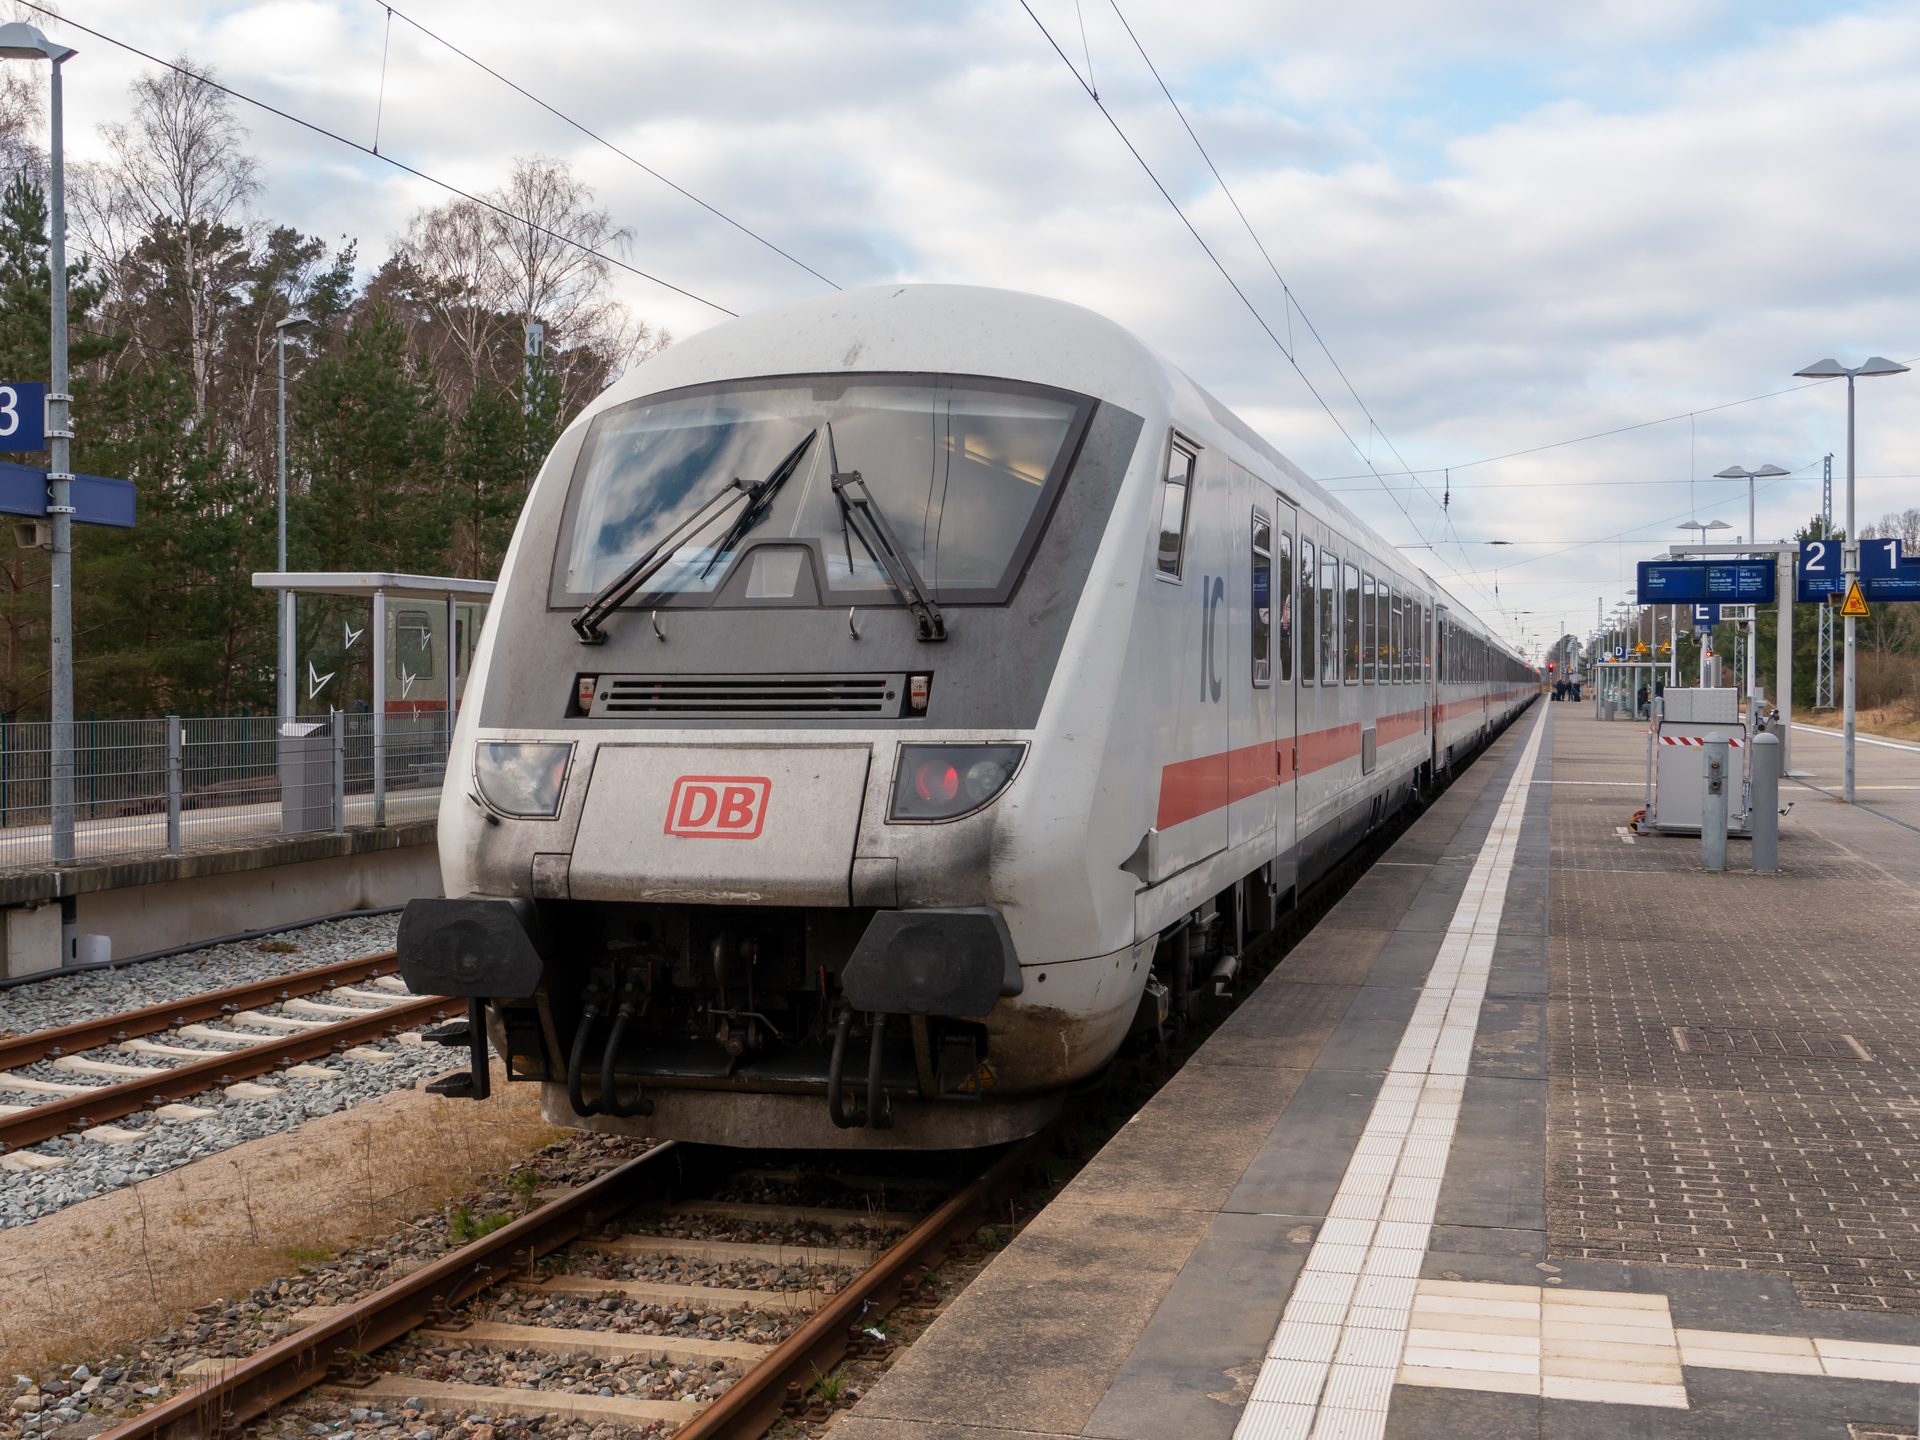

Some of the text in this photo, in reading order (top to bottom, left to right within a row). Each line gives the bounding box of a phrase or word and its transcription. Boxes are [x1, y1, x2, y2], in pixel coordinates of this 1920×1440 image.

[0, 386, 19, 437] 3
[1805, 541, 1826, 571] 2
[1883, 540, 1897, 569] 1
[1696, 603, 1710, 619] E
[1200, 575, 1224, 704] IC
[1616, 646, 1623, 656] D
[677, 786, 756, 829] DB
